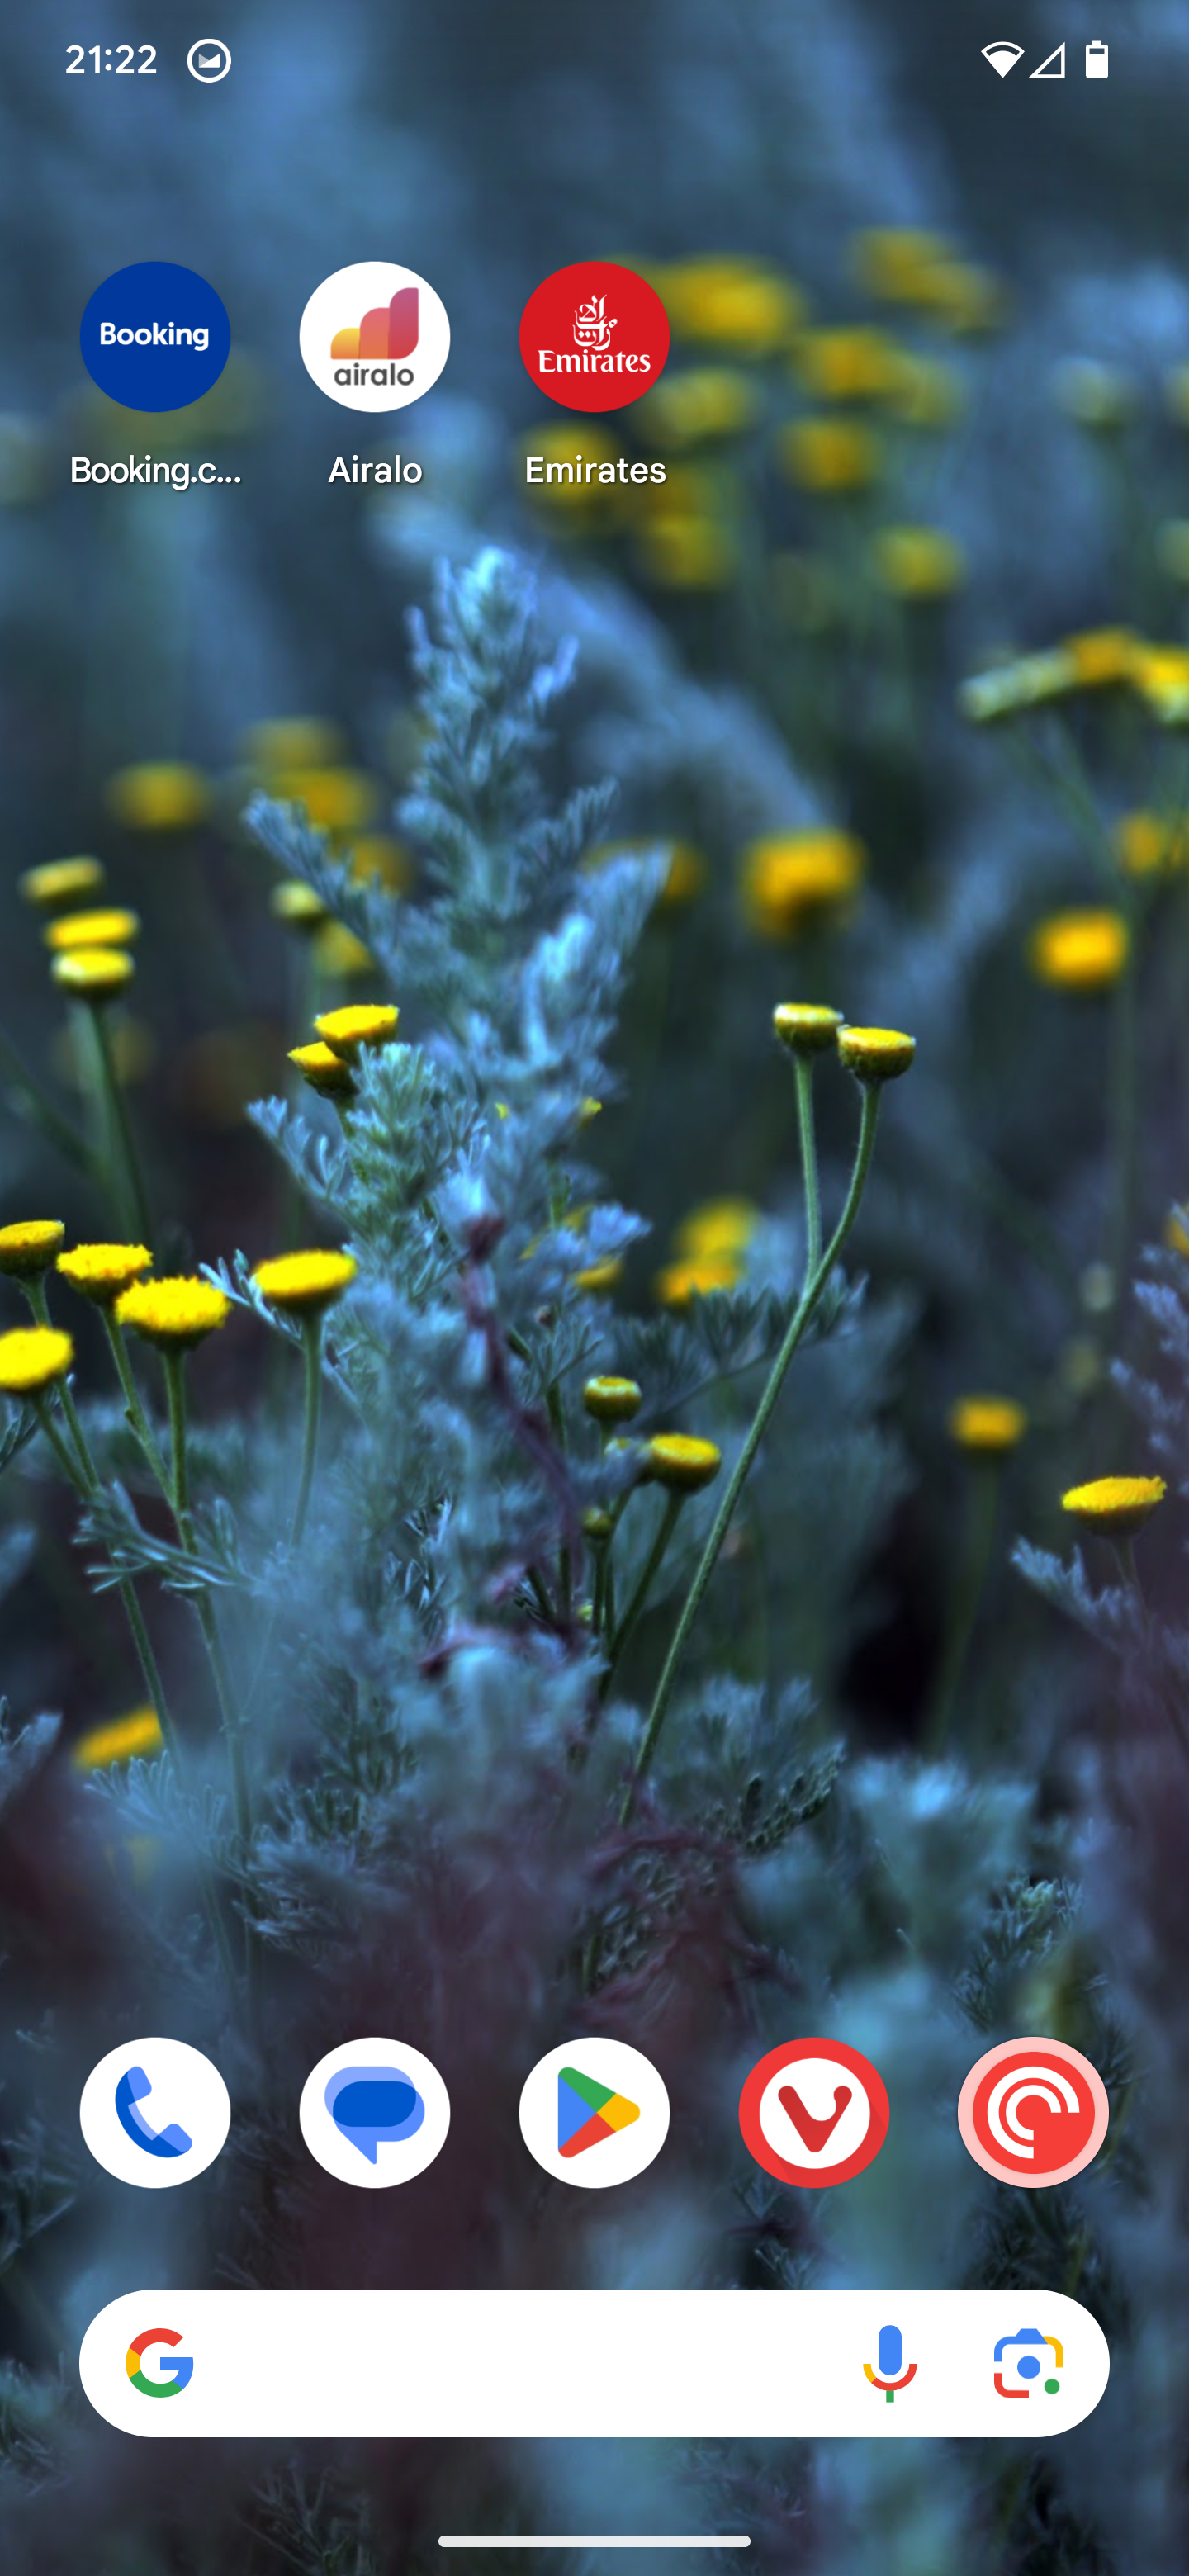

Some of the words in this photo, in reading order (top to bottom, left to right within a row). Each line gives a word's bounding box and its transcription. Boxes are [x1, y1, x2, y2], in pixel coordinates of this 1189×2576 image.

[65, 45, 157, 74] 21:22
[100, 321, 209, 351] Booking
[334, 362, 414, 386] airalo
[538, 348, 651, 372] Emirates
[71, 454, 241, 491] Booking.c...
[328, 454, 423, 484] Airalo
[526, 454, 666, 484] Emirates
